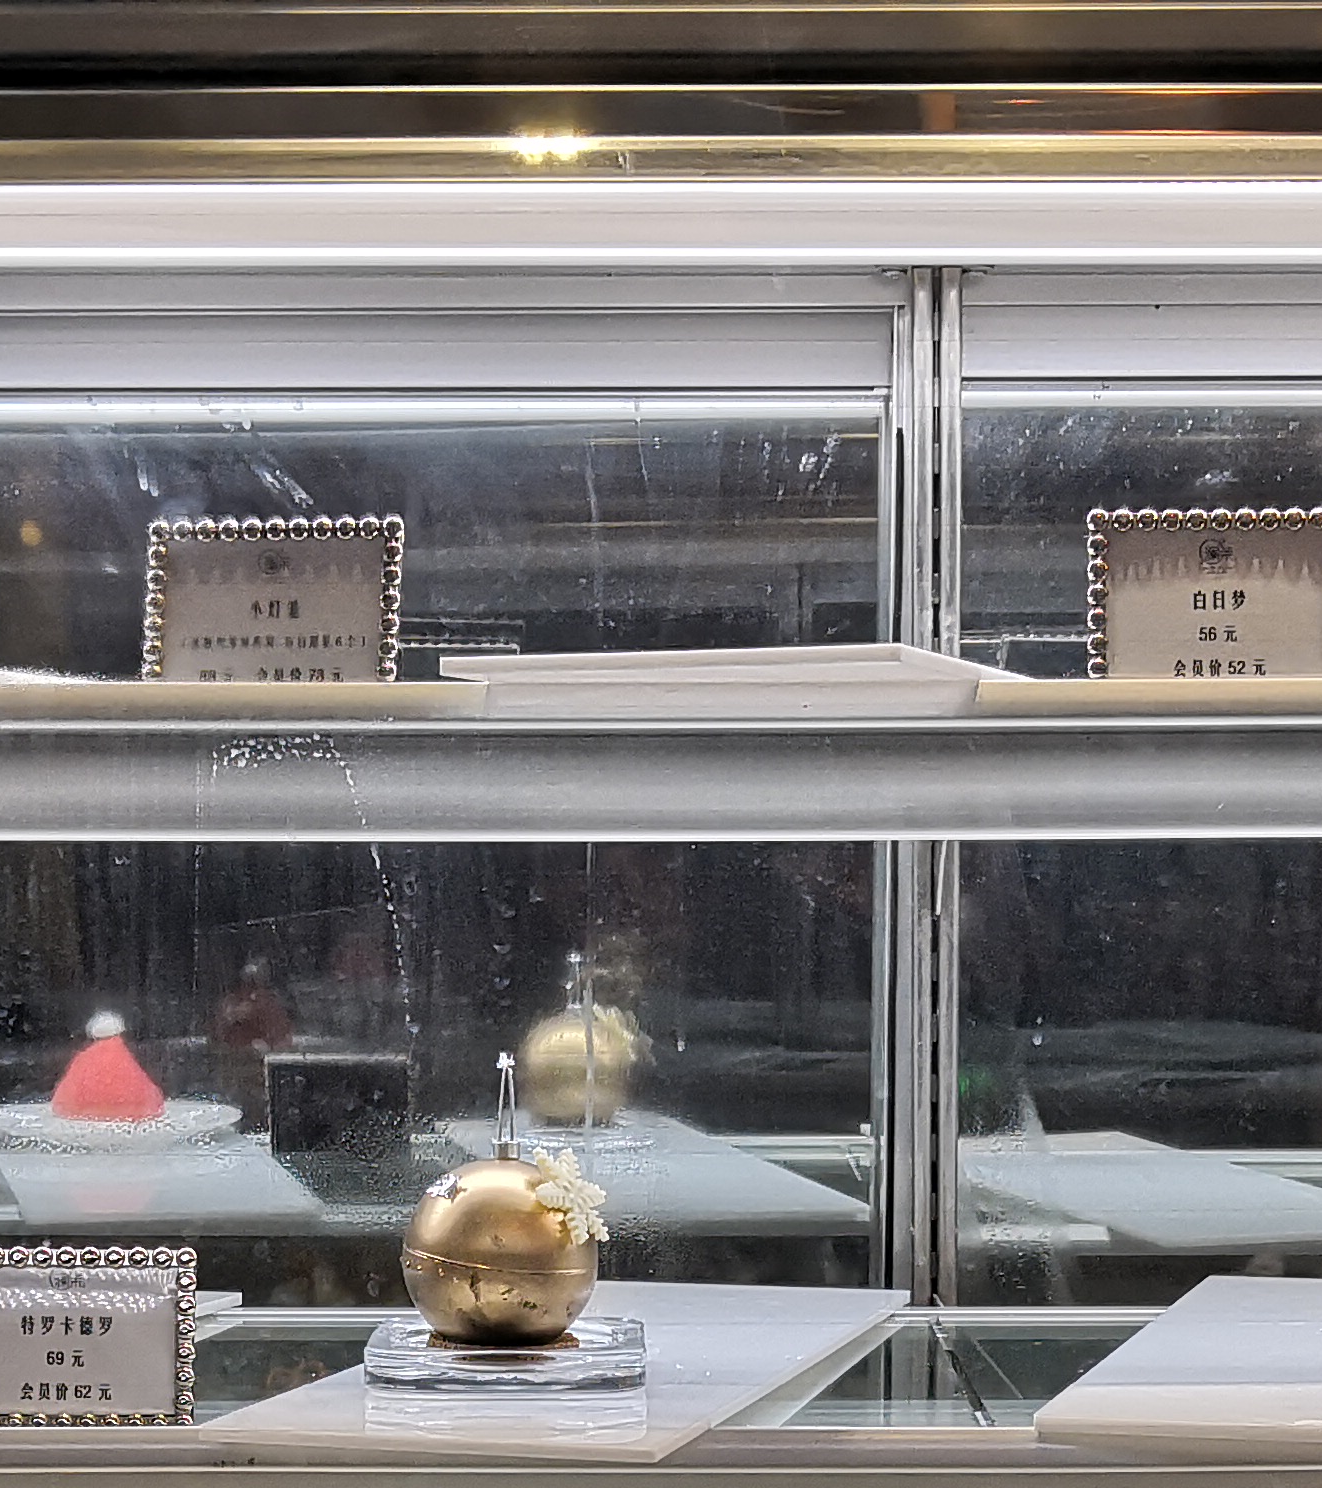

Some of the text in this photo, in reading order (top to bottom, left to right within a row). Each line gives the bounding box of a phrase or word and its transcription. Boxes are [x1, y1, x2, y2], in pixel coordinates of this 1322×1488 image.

[1192, 589, 1246, 610] 白日梦
[20, 1315, 113, 1336] 特罗卡德罗
